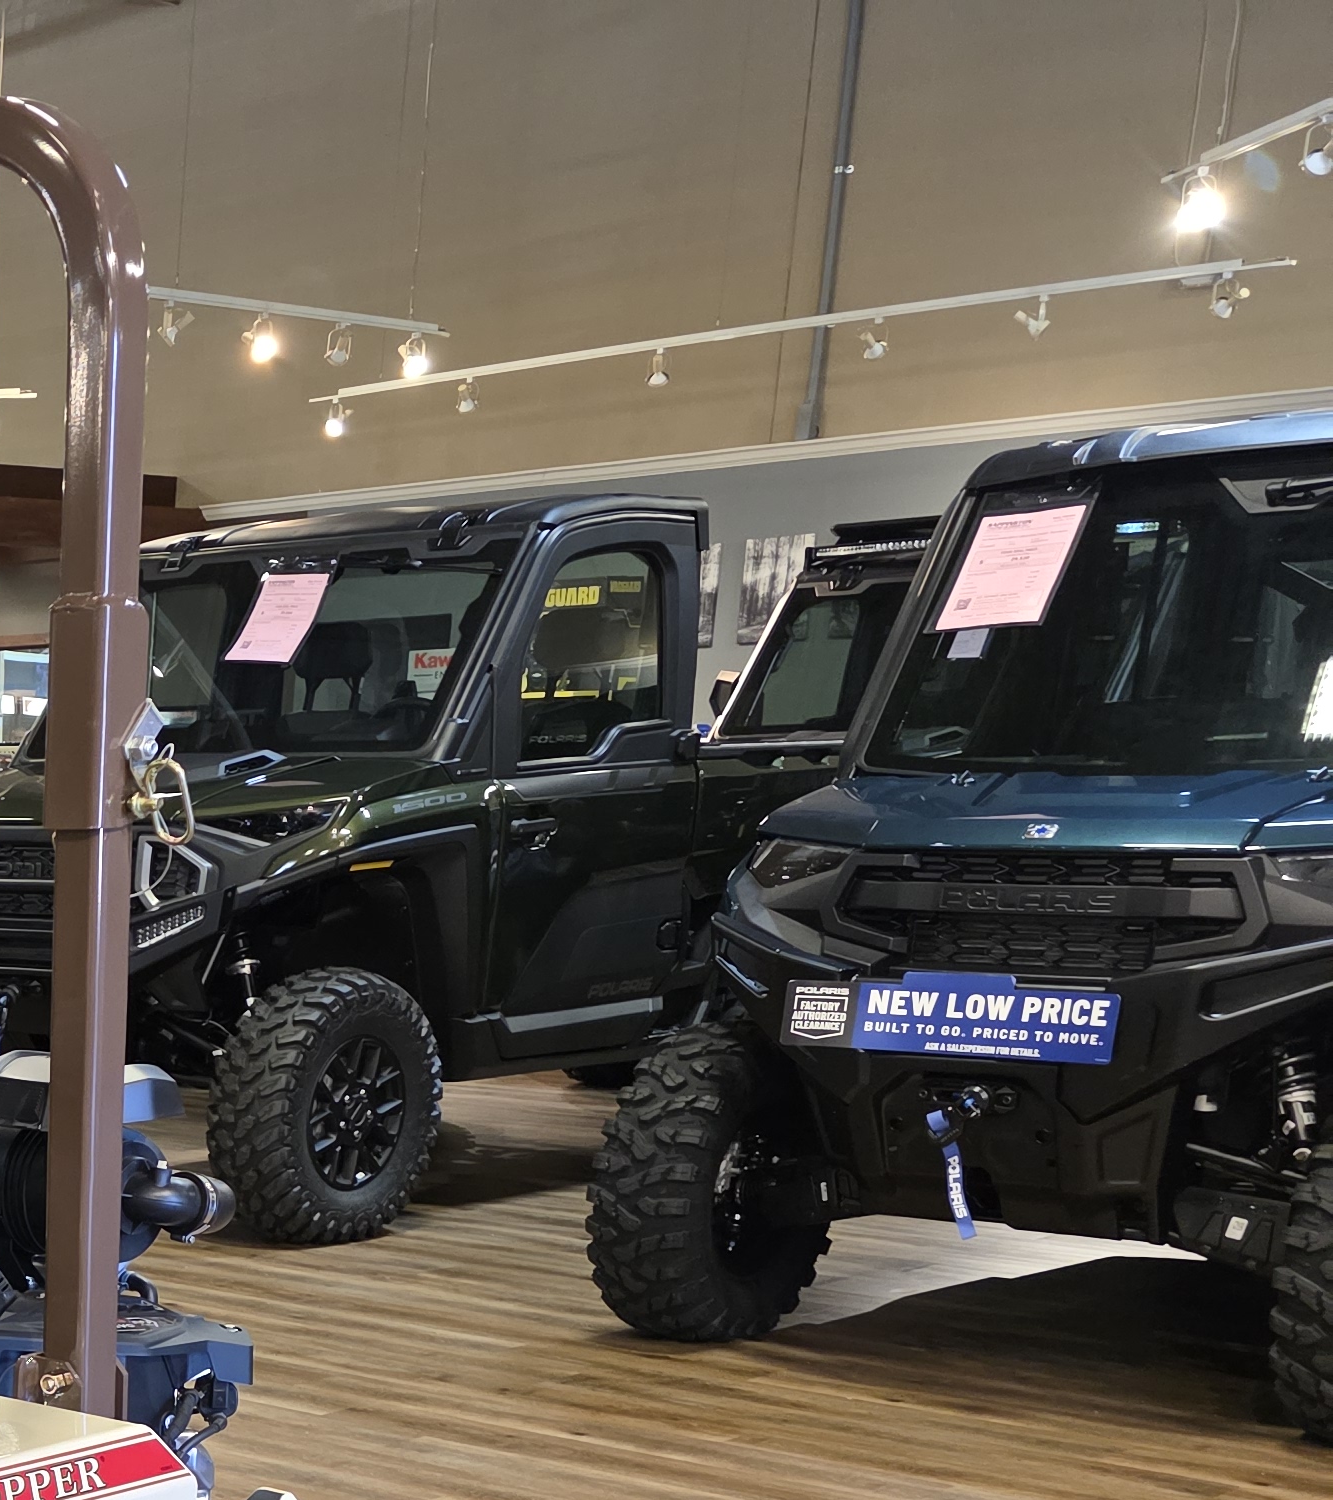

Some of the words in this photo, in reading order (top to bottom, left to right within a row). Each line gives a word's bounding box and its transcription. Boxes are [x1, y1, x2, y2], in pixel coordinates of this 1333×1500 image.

[545, 585, 601, 607] GUARD
[796, 986, 850, 996] POLARIS
[799, 1000, 841, 1012] FACTORY
[867, 989, 939, 1017] NEW
[945, 992, 1015, 1020] LOW
[1021, 996, 1111, 1027] PRICE
[792, 1010, 847, 1022] AUTHORIZED
[794, 1020, 841, 1031] CLEARANCE
[863, 1021, 910, 1035] BUILT
[916, 1023, 935, 1036] TO
[940, 1025, 966, 1038] GO.
[972, 1027, 1028, 1041] PRICED
[1034, 1030, 1053, 1043] TO
[1058, 1032, 1104, 1046] MOVE.
[924, 1042, 940, 1051] ASK
[940, 1043, 946, 1051] A
[996, 1047, 1010, 1055] FOR
[947, 1155, 968, 1219] POLARIS
